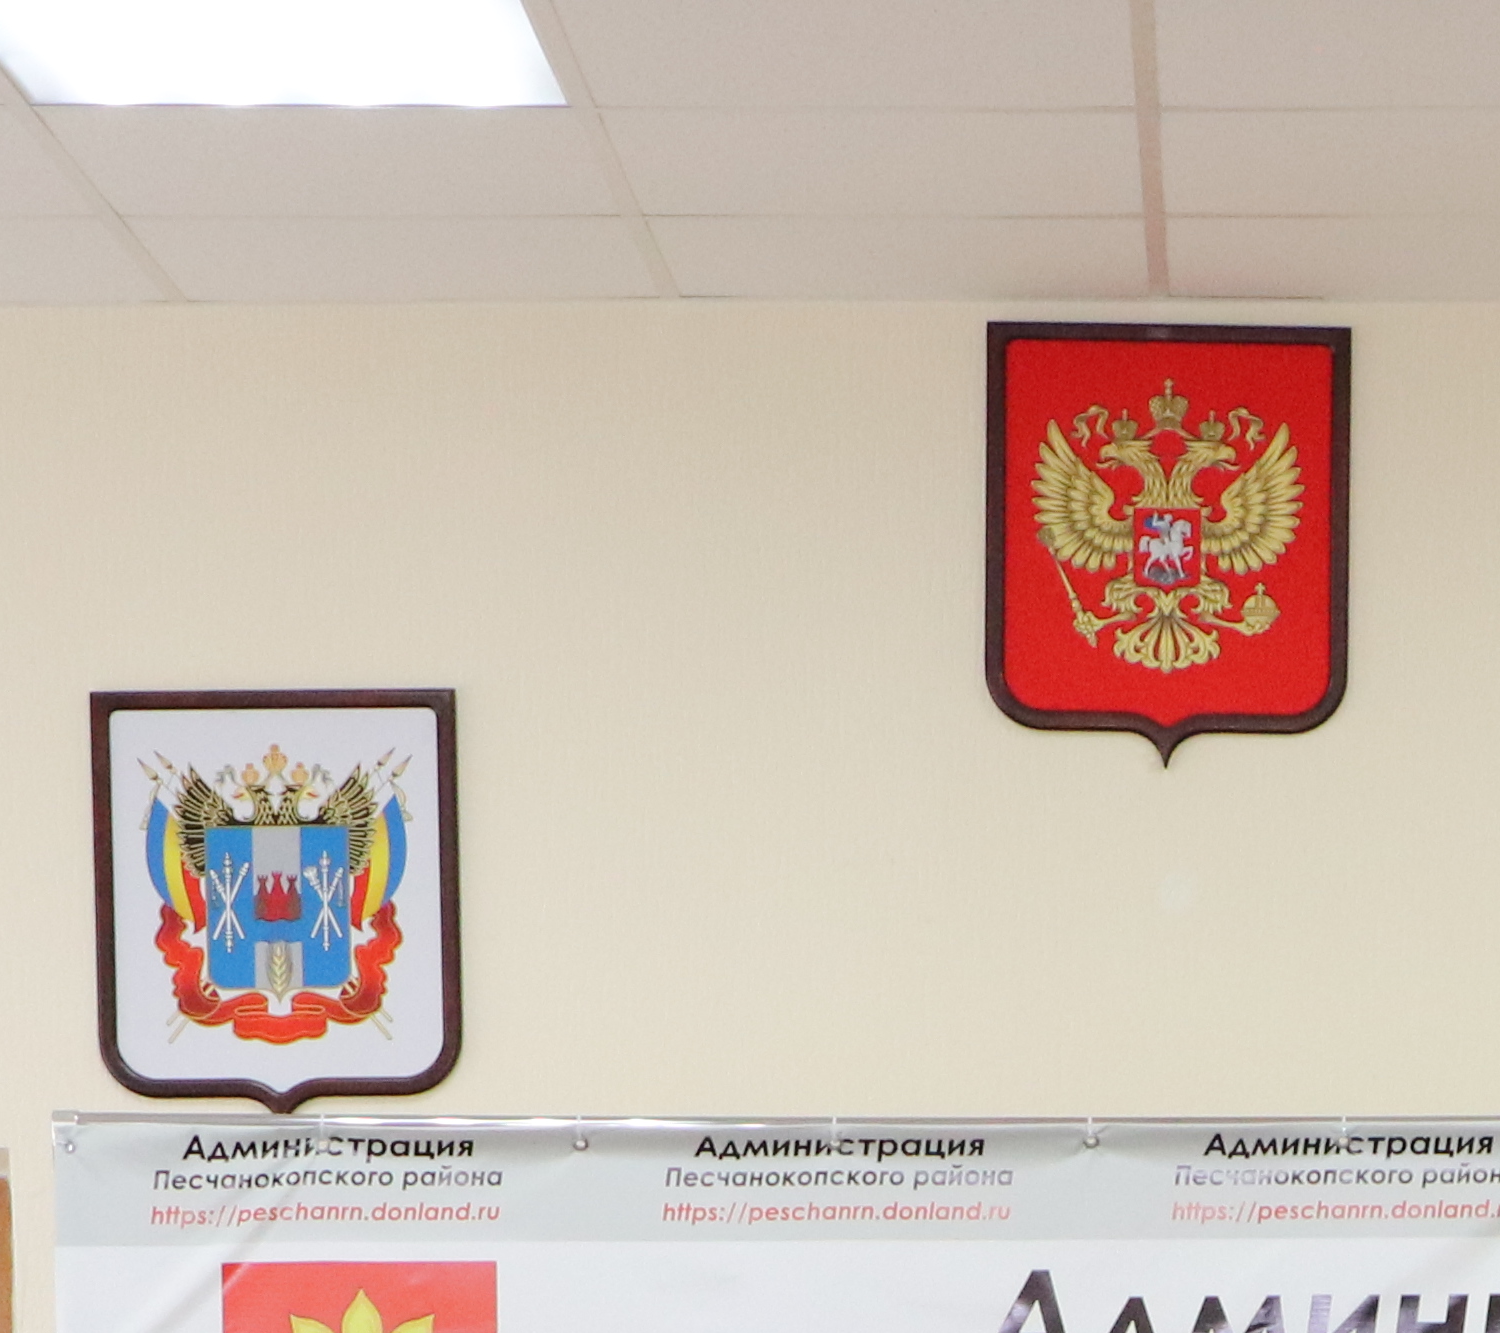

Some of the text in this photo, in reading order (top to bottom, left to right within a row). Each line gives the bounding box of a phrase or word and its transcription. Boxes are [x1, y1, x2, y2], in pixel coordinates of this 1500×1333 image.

[153, 1165, 503, 1190] Песчанокопского района
[665, 1164, 1014, 1189] Песчанокопского района
[1174, 1164, 1413, 1187] Песчанокопского
[150, 1201, 501, 1227] https://peschanrn.donland.ru
[662, 1202, 1011, 1224] https://peschanrn.donland.ru
